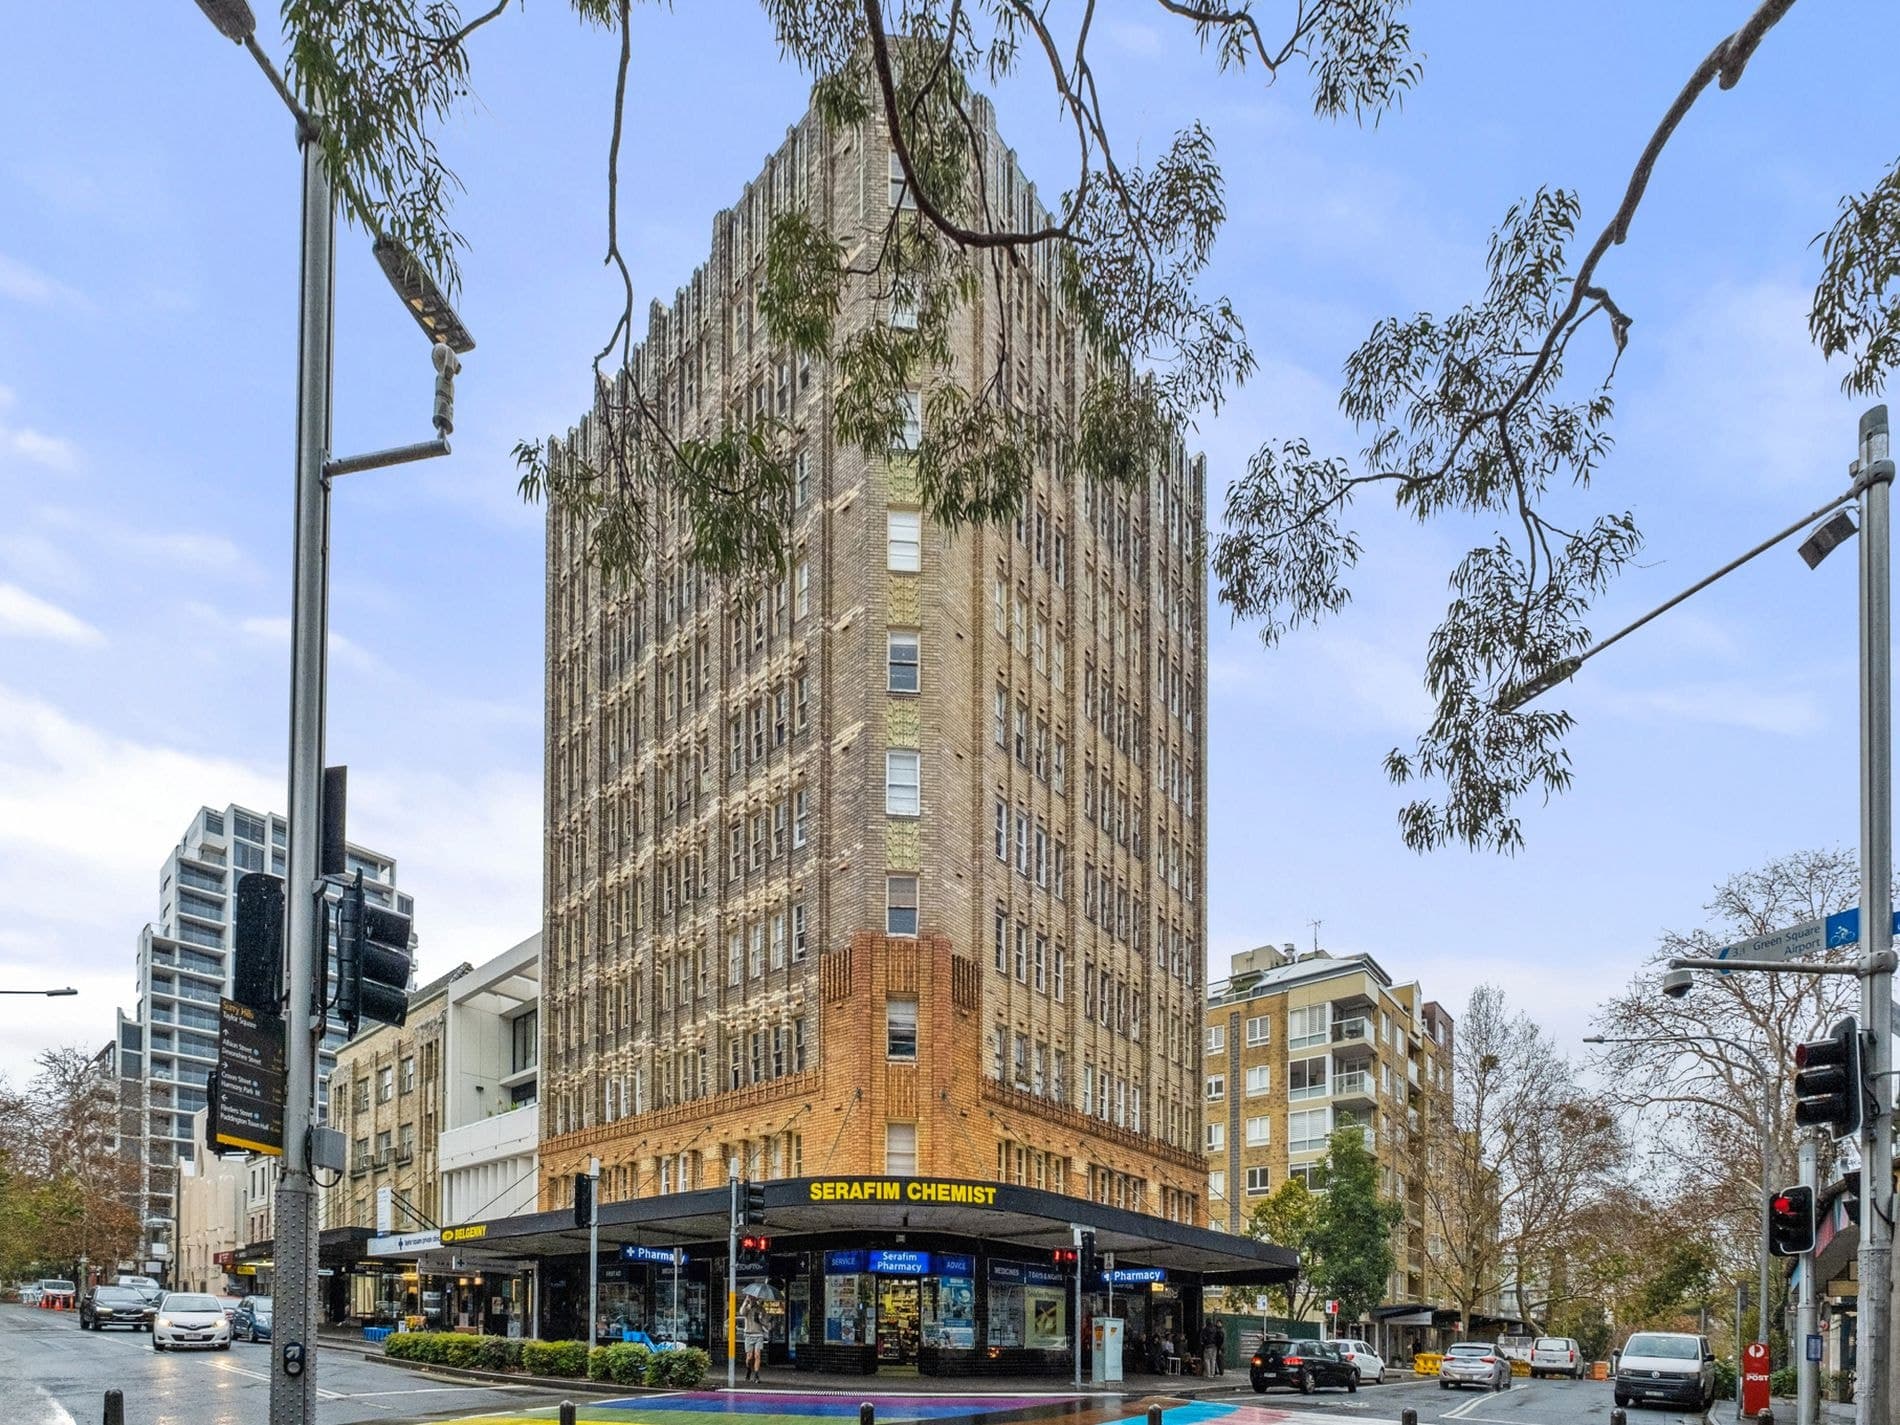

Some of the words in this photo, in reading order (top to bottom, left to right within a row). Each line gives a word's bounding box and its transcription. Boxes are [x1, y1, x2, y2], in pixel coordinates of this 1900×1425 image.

[1753, 936, 1783, 951] Green
[1785, 925, 1821, 943] Square
[1784, 938, 1821, 956] Airport
[239, 1017, 257, 1029] Square
[810, 1182, 901, 1201] SERAFIM
[907, 1183, 997, 1204] CHEMIST
[454, 1225, 487, 1240] BELGENNY
[638, 1247, 685, 1265] Pharmay
[831, 1257, 856, 1267] SERVICE
[882, 1251, 918, 1262] Serafim
[877, 1261, 922, 1272] Pharmacy
[946, 1261, 967, 1270] ADVICE
[1114, 1271, 1161, 1281] Pharmacy
